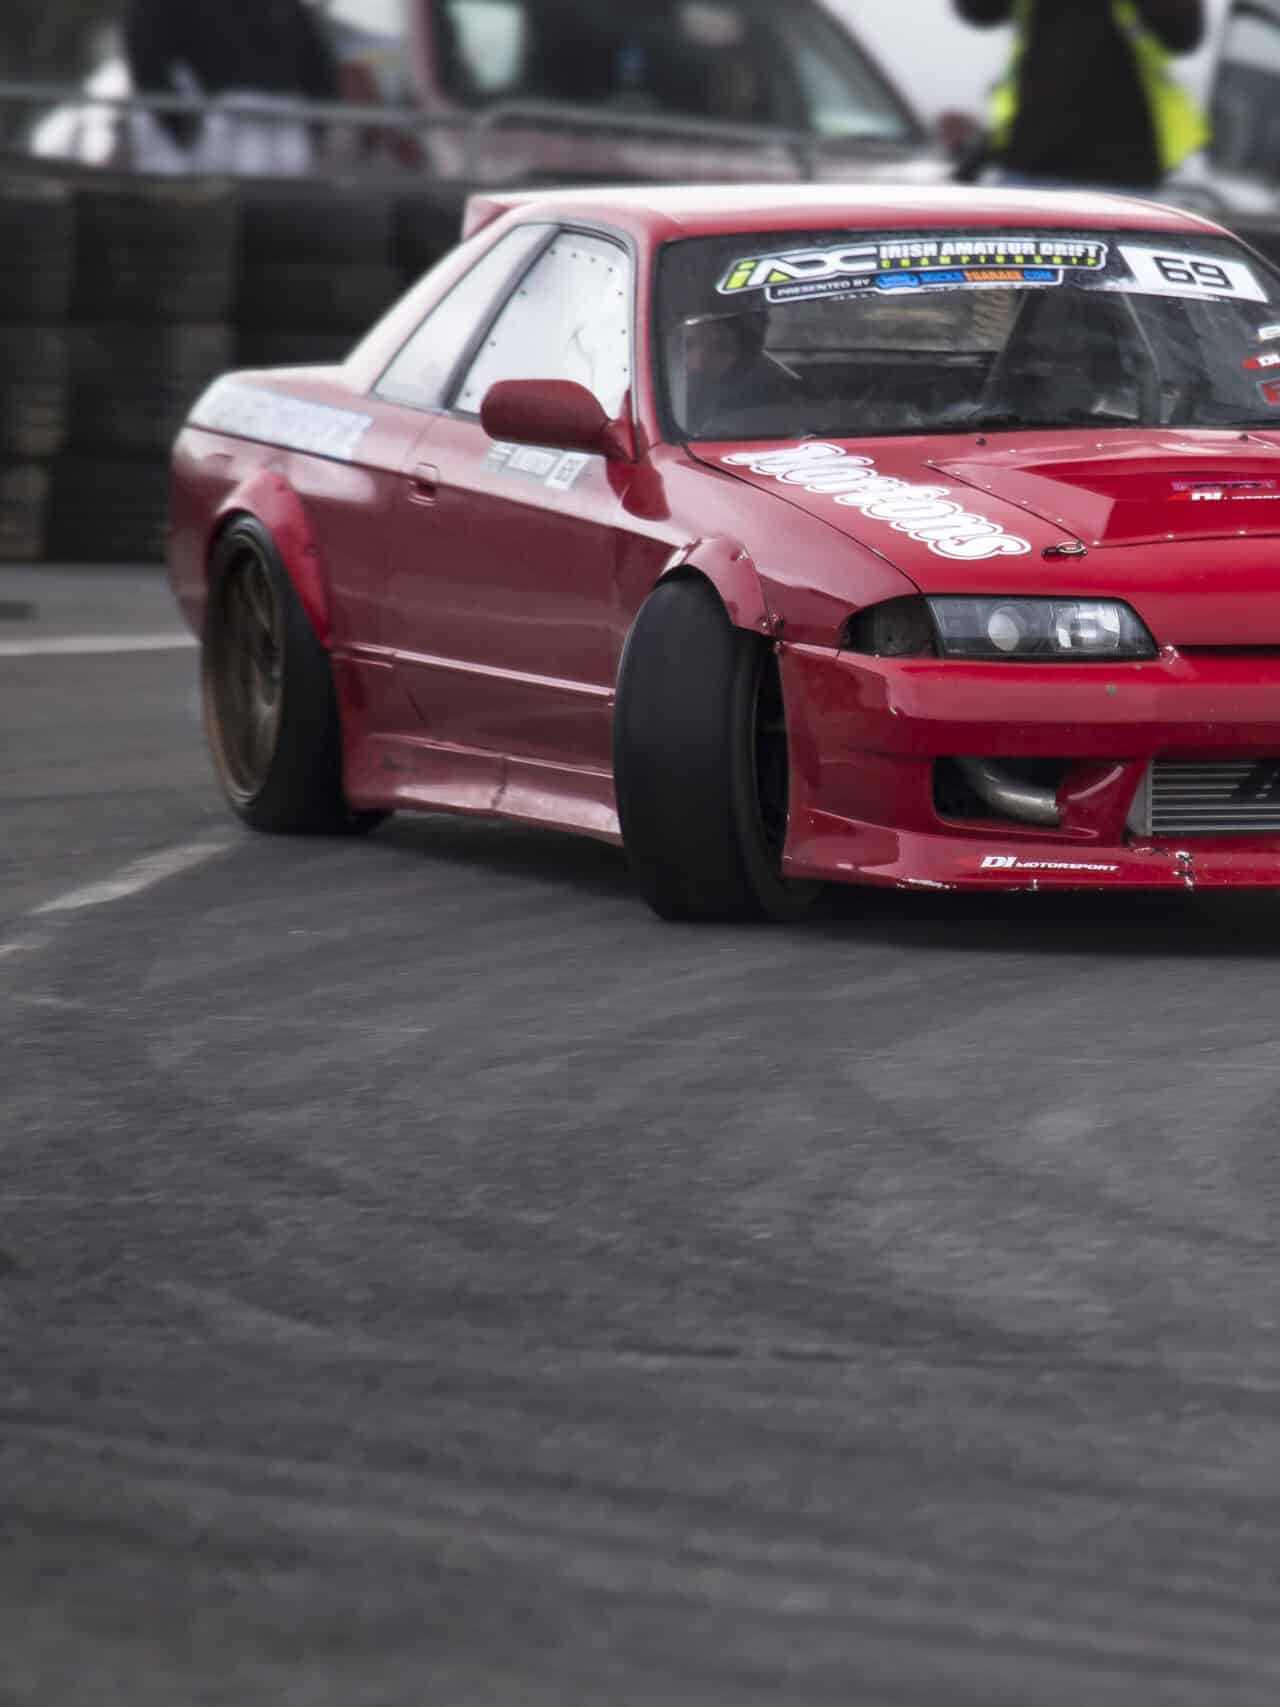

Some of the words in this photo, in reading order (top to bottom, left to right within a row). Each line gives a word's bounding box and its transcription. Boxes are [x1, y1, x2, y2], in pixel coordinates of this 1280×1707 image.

[879, 242, 938, 259] IRISH
[940, 241, 1036, 256] AMATEUR
[1039, 241, 1099, 258] DRIFT
[1152, 256, 1235, 290] 69
[1016, 861, 1120, 871] MOTORSPORT
